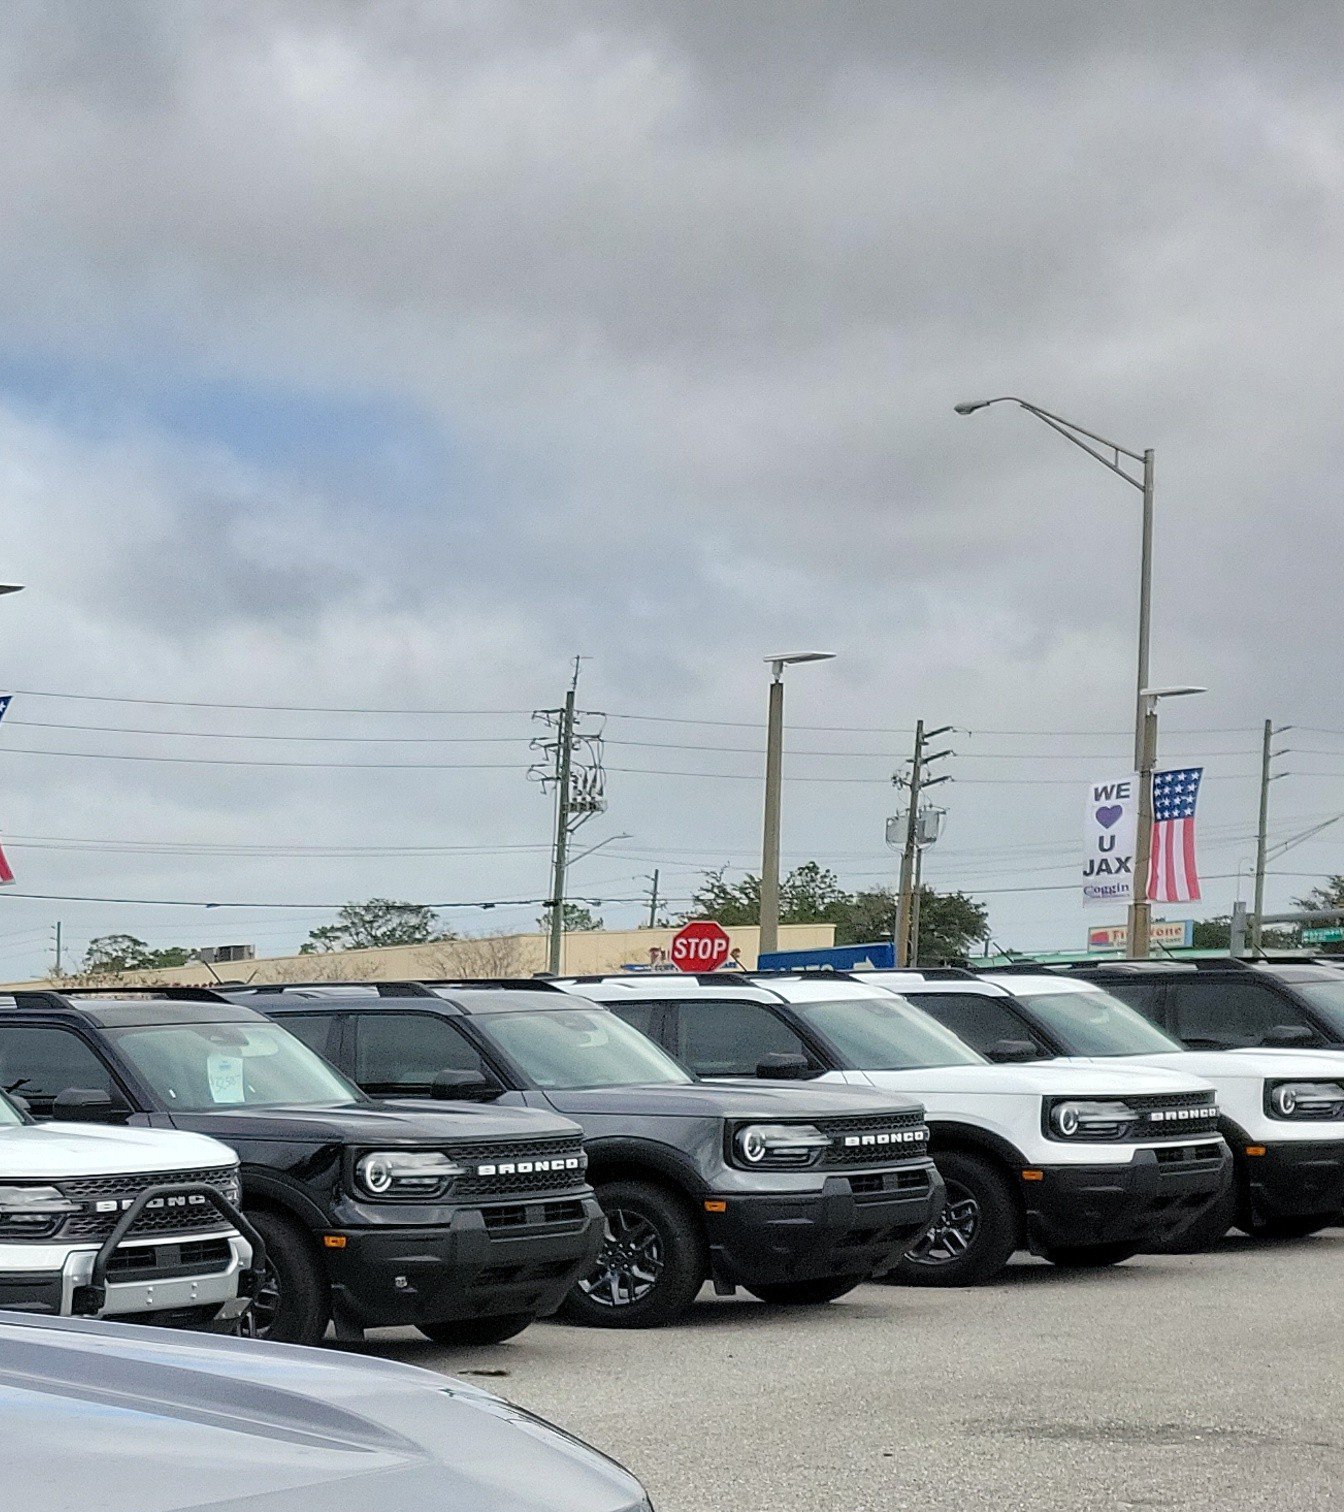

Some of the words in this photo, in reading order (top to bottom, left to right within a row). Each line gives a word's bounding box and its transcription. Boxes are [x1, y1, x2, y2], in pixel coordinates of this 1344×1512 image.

[1094, 782, 1131, 801] WE
[1098, 835, 1116, 852] U
[1082, 856, 1132, 877] JAX
[1083, 883, 1130, 898] Coggin
[673, 937, 727, 960] STOP
[1150, 1107, 1217, 1122] BRONCO
[844, 1130, 924, 1147] BRONCO
[477, 1158, 579, 1176] BRONCO
